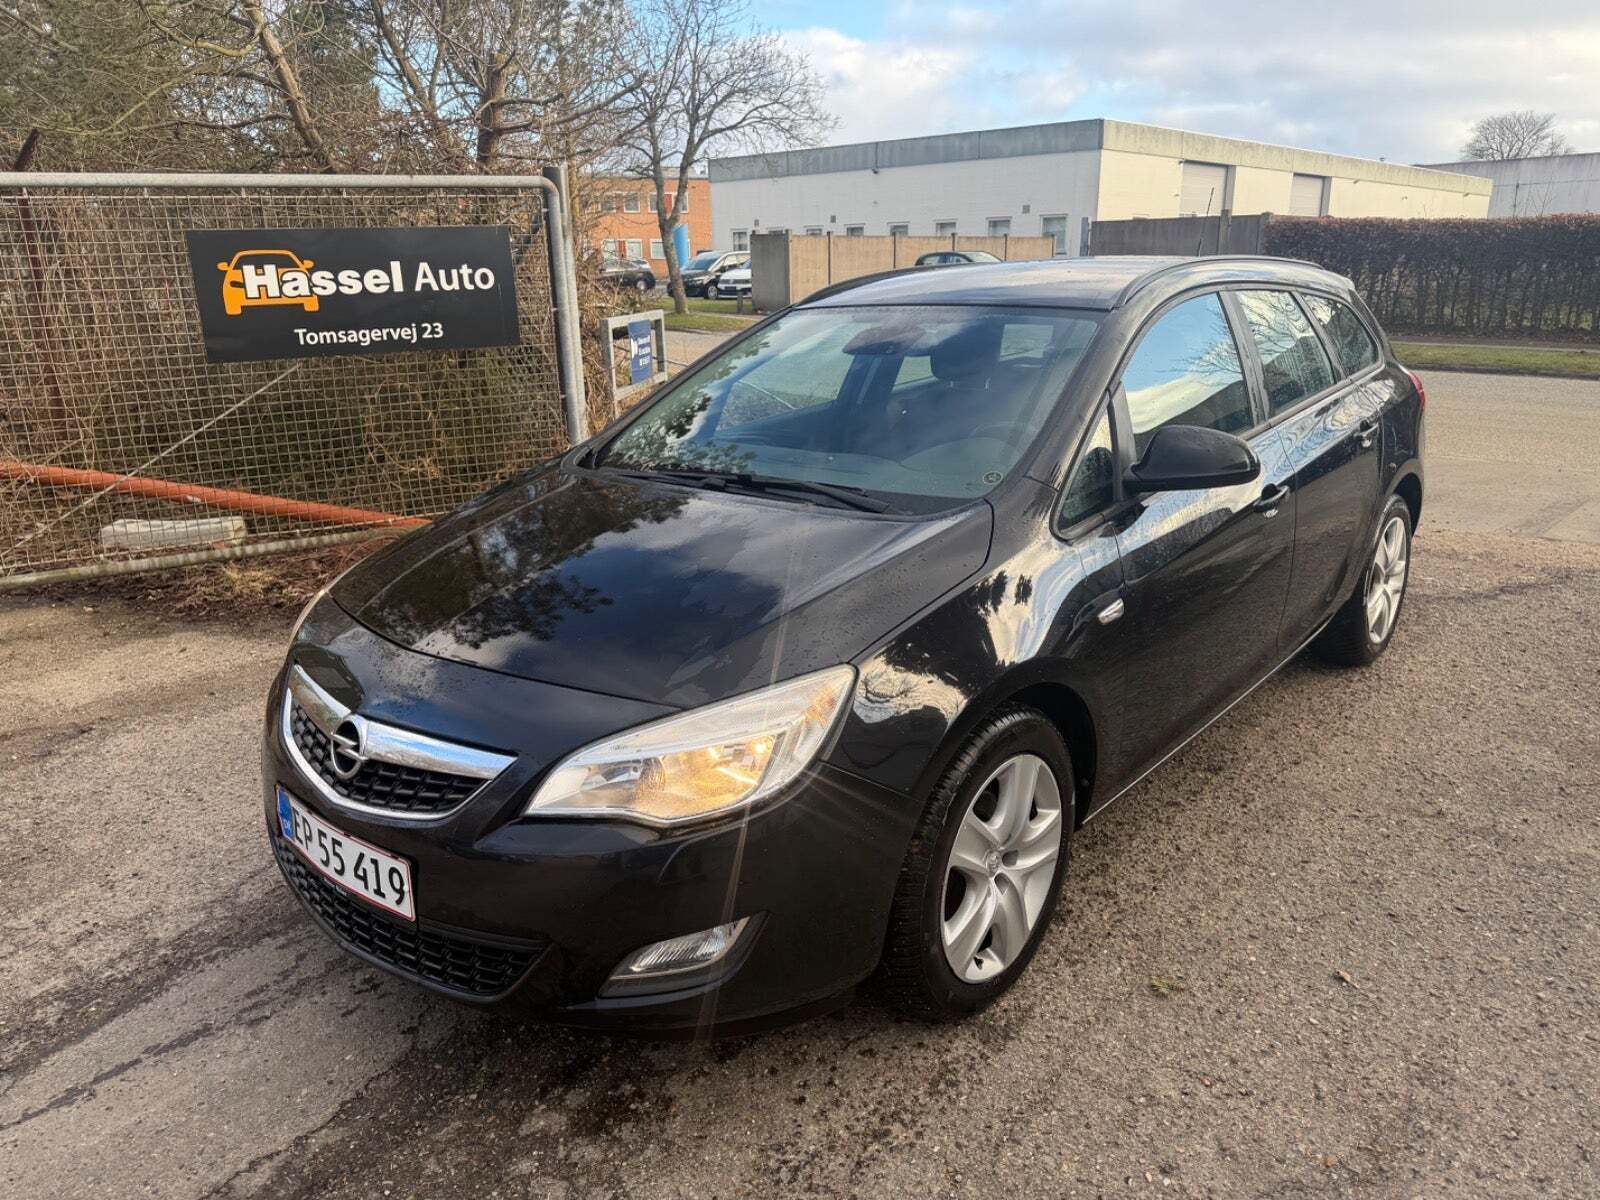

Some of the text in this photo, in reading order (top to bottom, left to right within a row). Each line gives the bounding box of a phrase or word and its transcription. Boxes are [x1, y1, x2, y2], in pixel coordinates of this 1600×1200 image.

[242, 261, 495, 298] Hassel Auto
[294, 322, 444, 346] Tomsagervej 23
[317, 828, 345, 876] 55
[353, 852, 405, 906] 419
